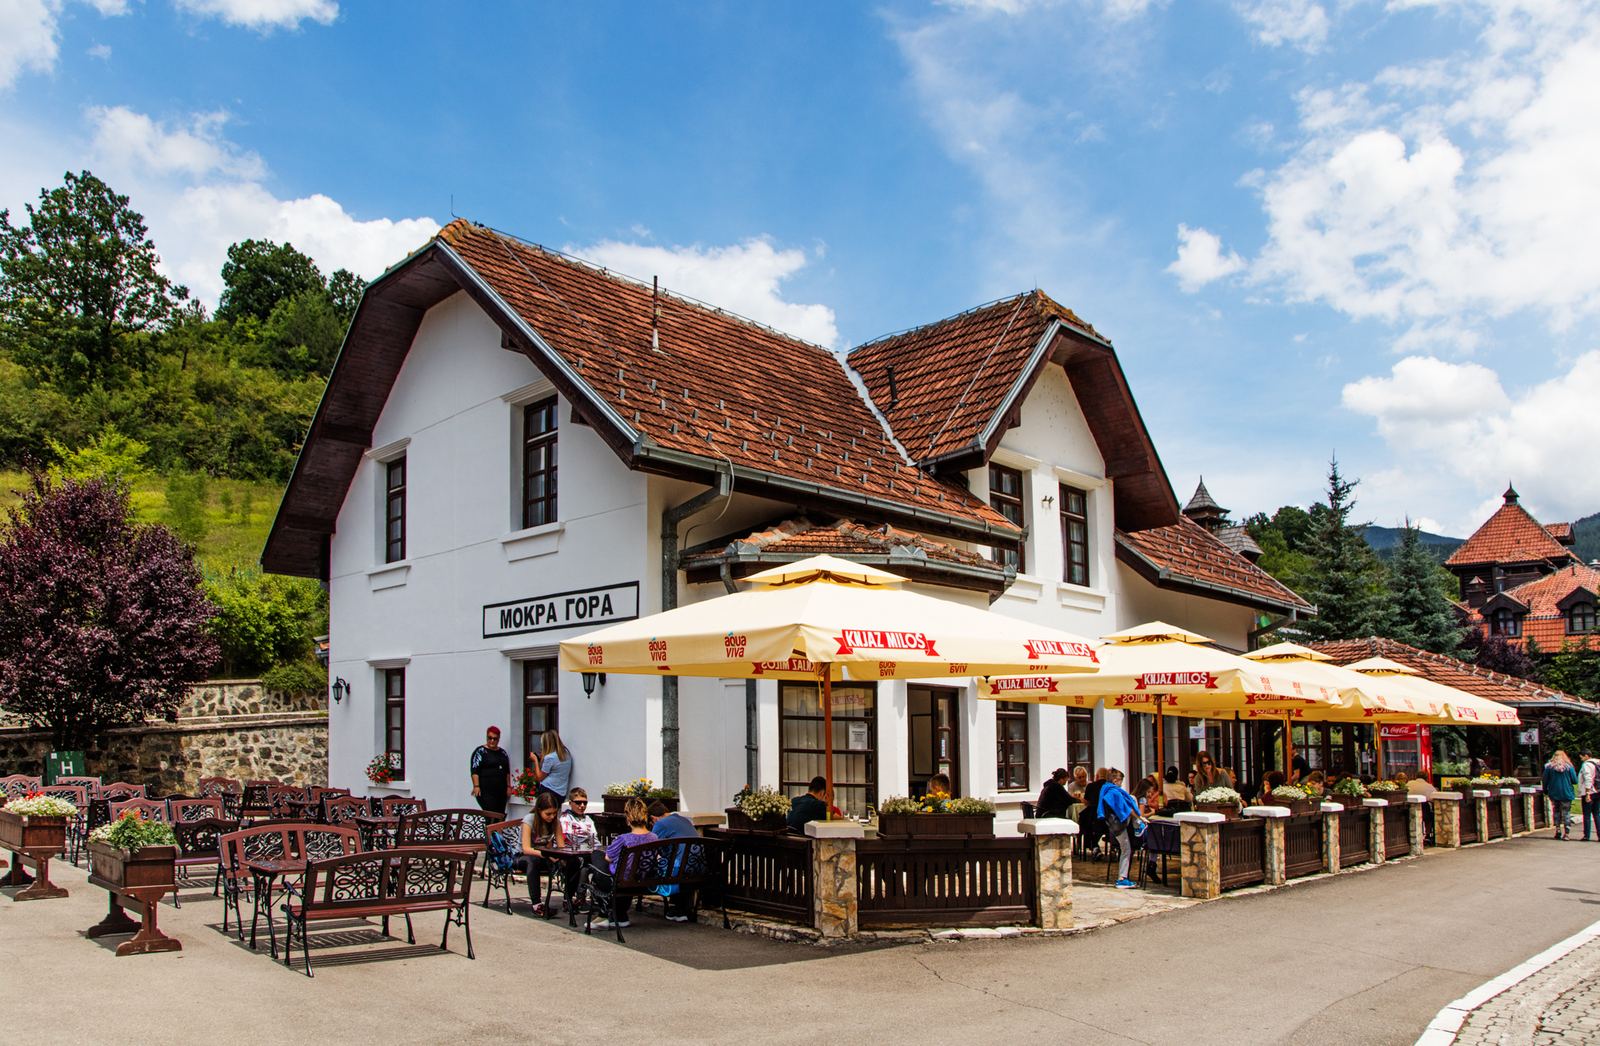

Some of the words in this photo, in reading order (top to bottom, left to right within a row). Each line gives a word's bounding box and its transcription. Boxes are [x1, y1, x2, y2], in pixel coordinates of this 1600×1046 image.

[500, 602, 557, 629] МОКРА
[565, 593, 614, 621] ГОРА
[724, 635, 747, 647] aqua
[844, 630, 884, 647] KNJAZ
[726, 647, 745, 657] viva
[1031, 640, 1061, 654] KNJAZ
[997, 678, 1021, 690] KNJAZ
[1143, 673, 1172, 685] KNJAZ
[61, 760, 74, 775] H
